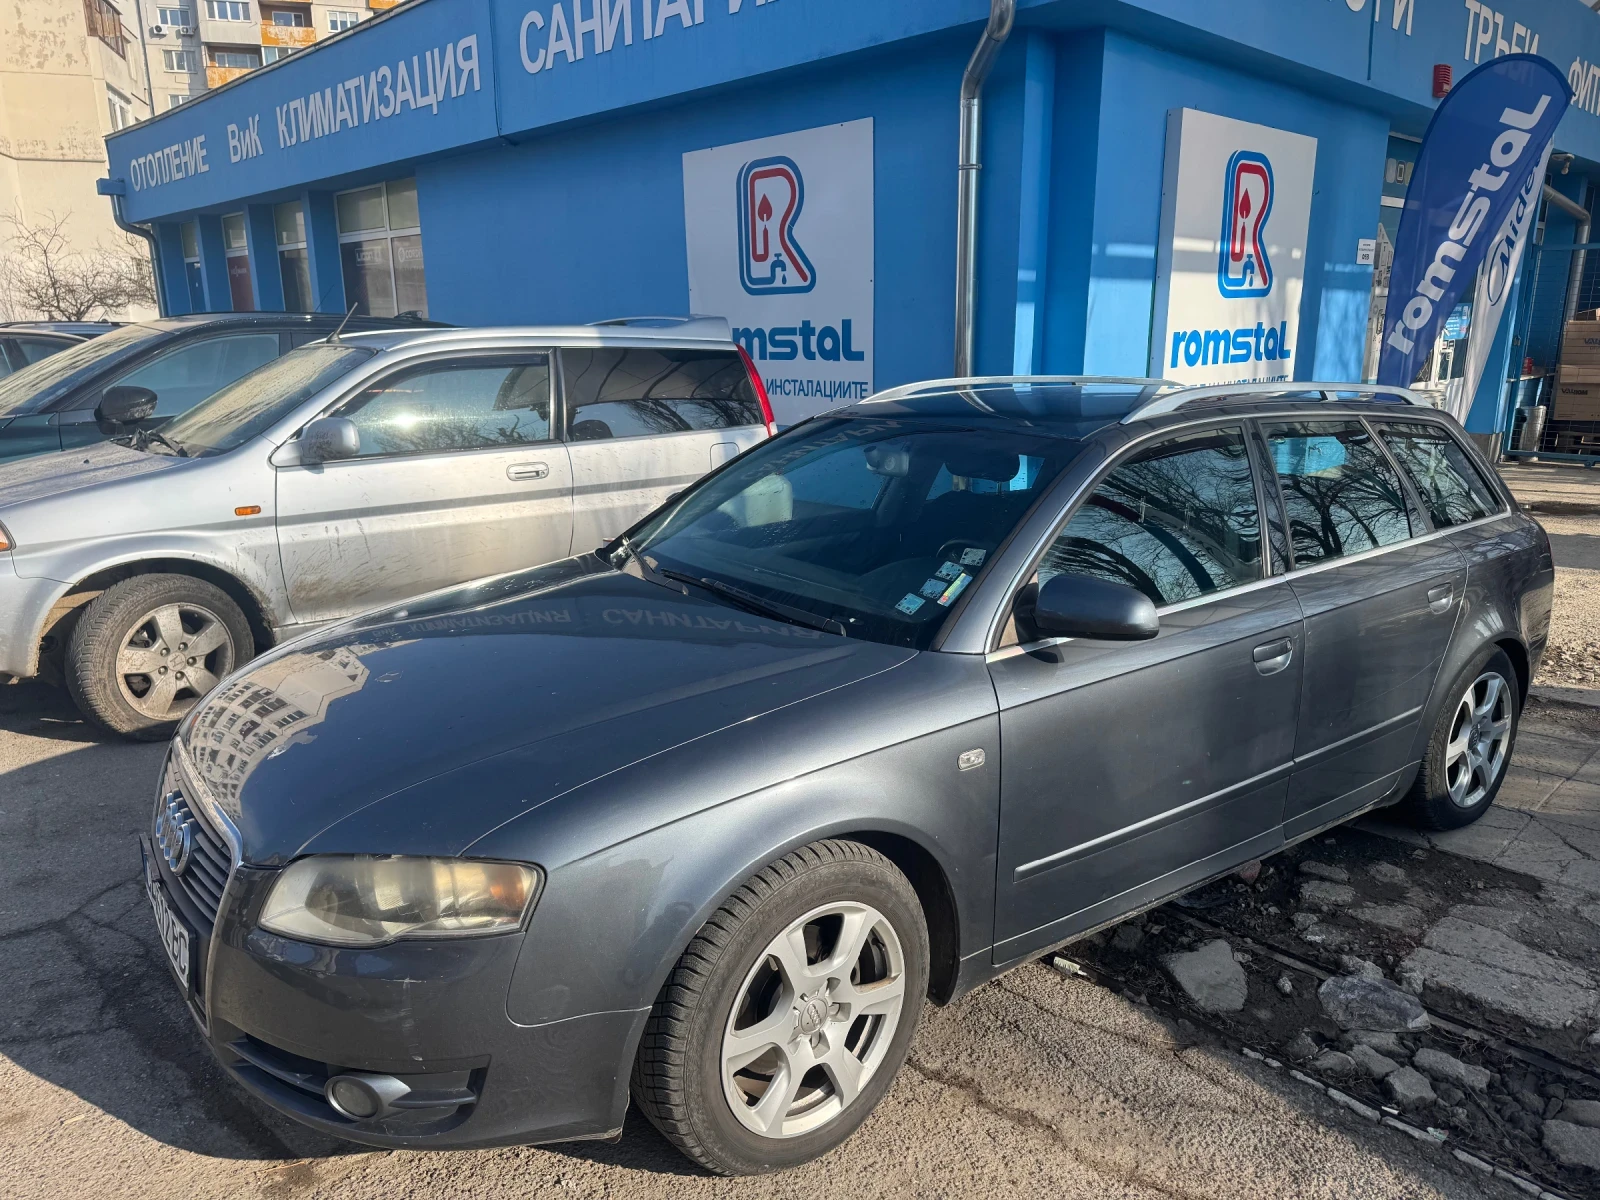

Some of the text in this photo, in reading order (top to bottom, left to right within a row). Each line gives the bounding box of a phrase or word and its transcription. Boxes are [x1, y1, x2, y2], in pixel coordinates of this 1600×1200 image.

[519, 0, 780, 74] САНИТА
[130, 34, 481, 192] ОТОПЛЕНИЕ ВиК КЛИМАТИЗАЦИЯ
[1492, 157, 1541, 295] Mide
[732, 319, 864, 361] mstal
[766, 378, 868, 402] ИНСТАЛАЦИИТЕ
